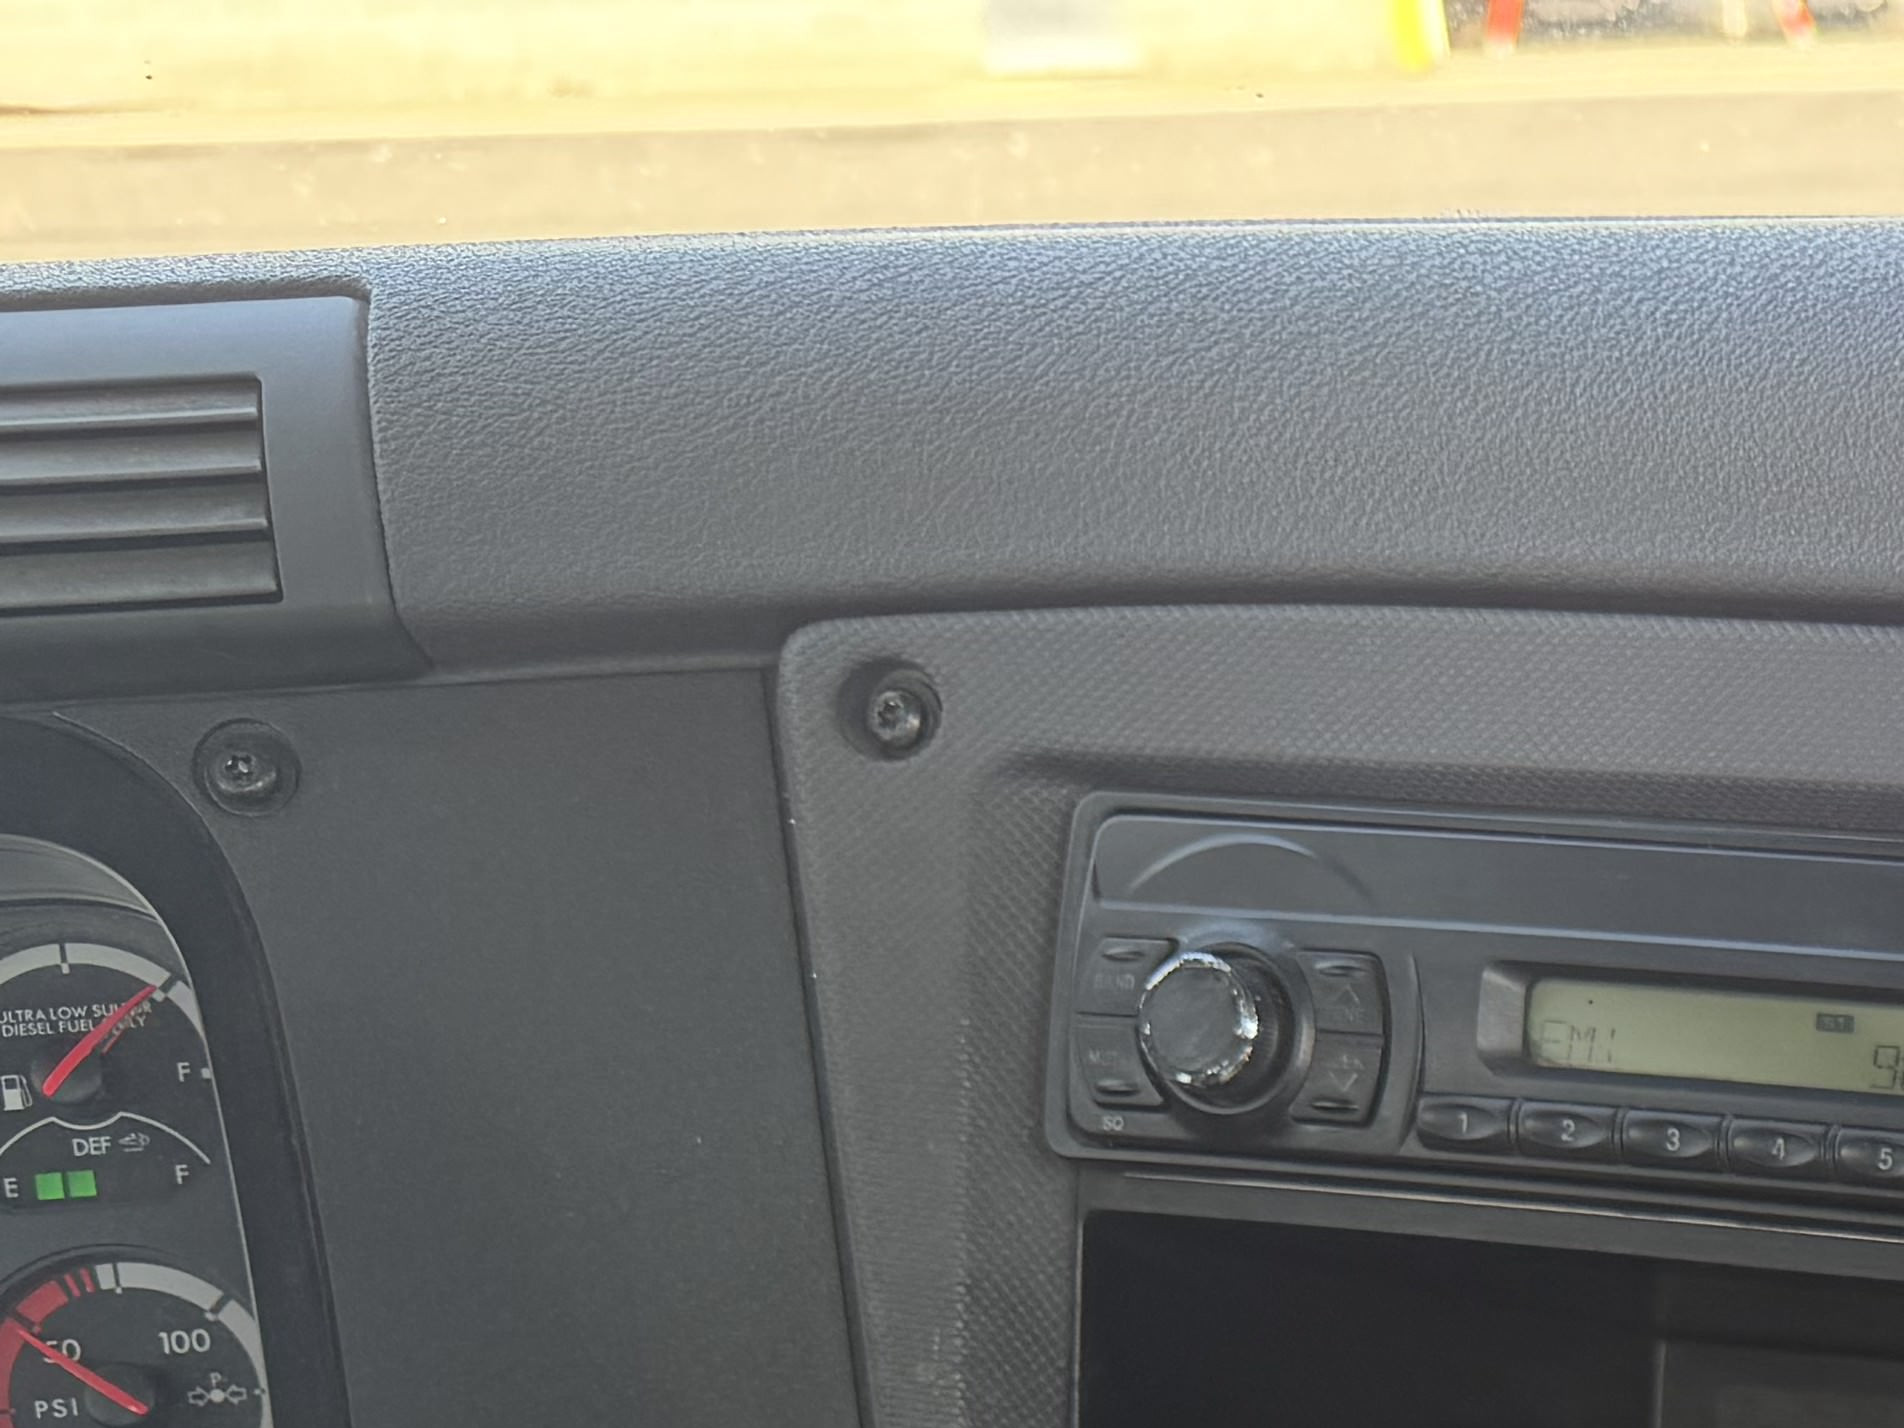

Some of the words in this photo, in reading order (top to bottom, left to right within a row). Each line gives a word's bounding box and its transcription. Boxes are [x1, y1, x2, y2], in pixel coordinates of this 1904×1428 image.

[50, 1006, 87, 1020] LOW
[2, 1021, 55, 1037] DIESEL
[59, 1019, 95, 1033] FUEL
[177, 1062, 191, 1082] F
[1457, 1113, 1468, 1134] 1
[1560, 1120, 1575, 1142] 2
[72, 1136, 112, 1157] DEF
[1666, 1129, 1681, 1151] 3
[1772, 1136, 1786, 1160] 4
[1877, 1148, 1893, 1171] 5
[175, 1164, 189, 1184] F
[3, 1178, 19, 1198] E
[43, 1338, 82, 1363] 50
[158, 1328, 211, 1355] 100
[34, 1398, 79, 1419] PSI
